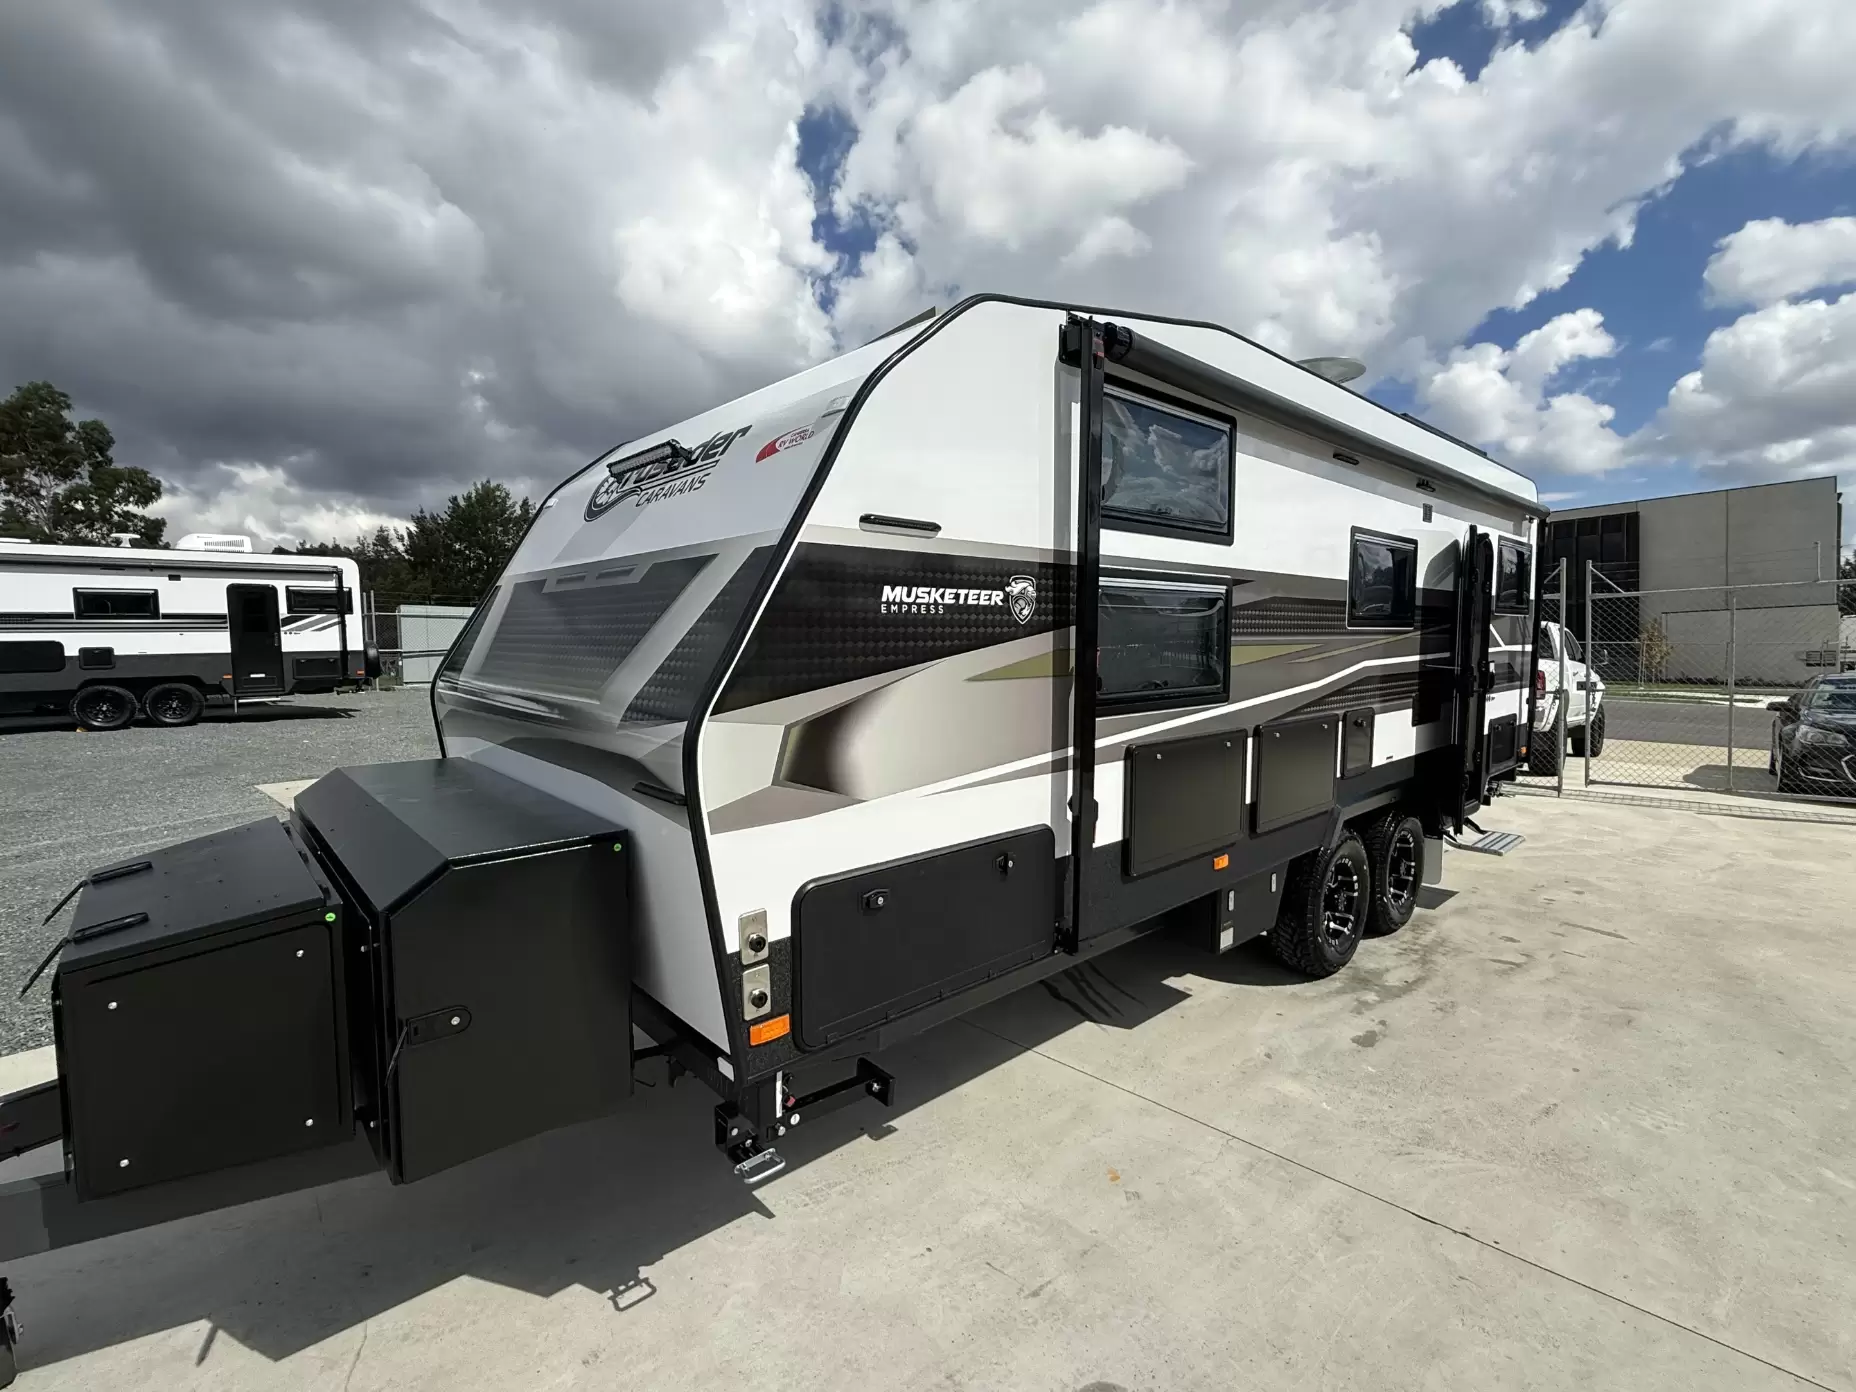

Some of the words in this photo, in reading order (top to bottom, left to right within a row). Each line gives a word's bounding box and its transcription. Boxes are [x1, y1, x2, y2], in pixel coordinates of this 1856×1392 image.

[635, 472, 712, 508] CARAVANS
[881, 585, 1004, 606] MUSKETEER
[881, 603, 944, 614] EMPRESS
